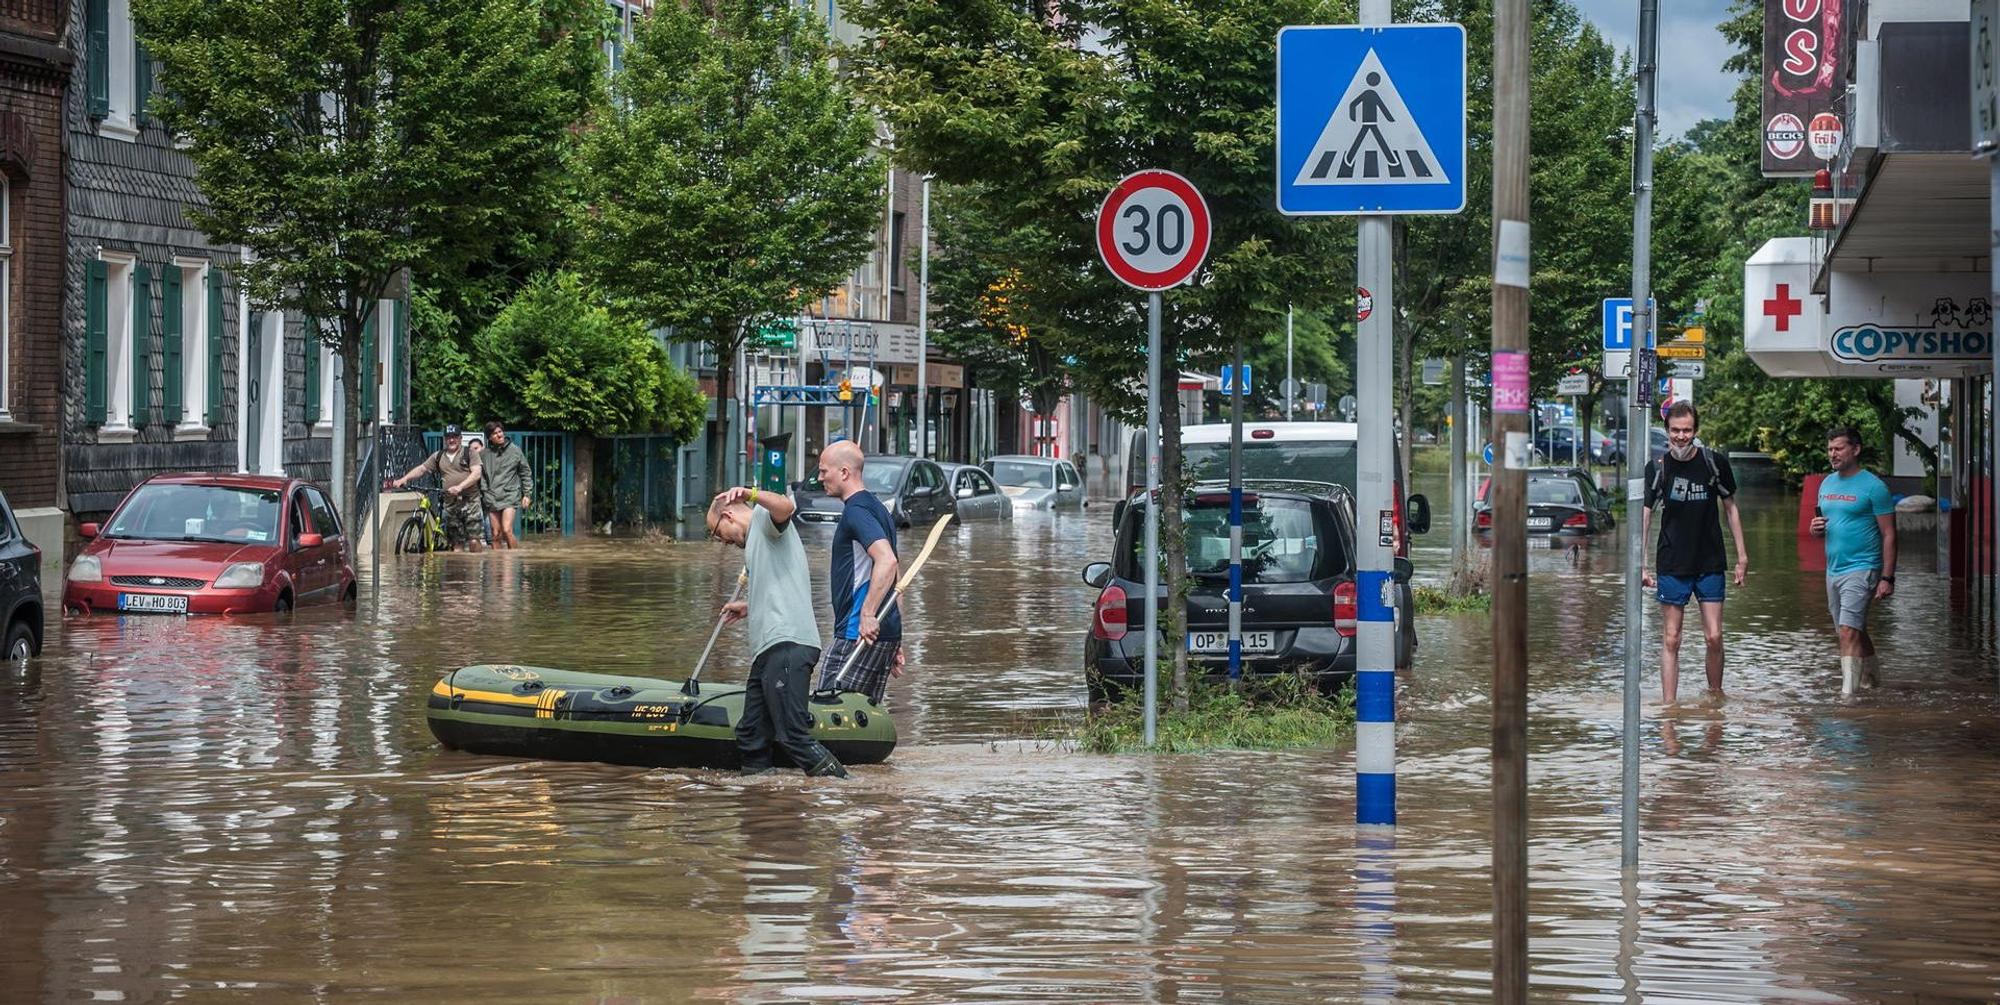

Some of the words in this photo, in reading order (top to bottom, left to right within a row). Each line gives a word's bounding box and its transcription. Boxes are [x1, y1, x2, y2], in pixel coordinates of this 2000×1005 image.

[1122, 204, 1185, 256] 30
[1836, 327, 1993, 357] COPYSHO
[771, 451, 780, 465] P
[125, 595, 145, 607] LEV
[167, 597, 186, 609] 803
[1195, 633, 1216, 649] OP
[1248, 633, 1268, 648] 15
